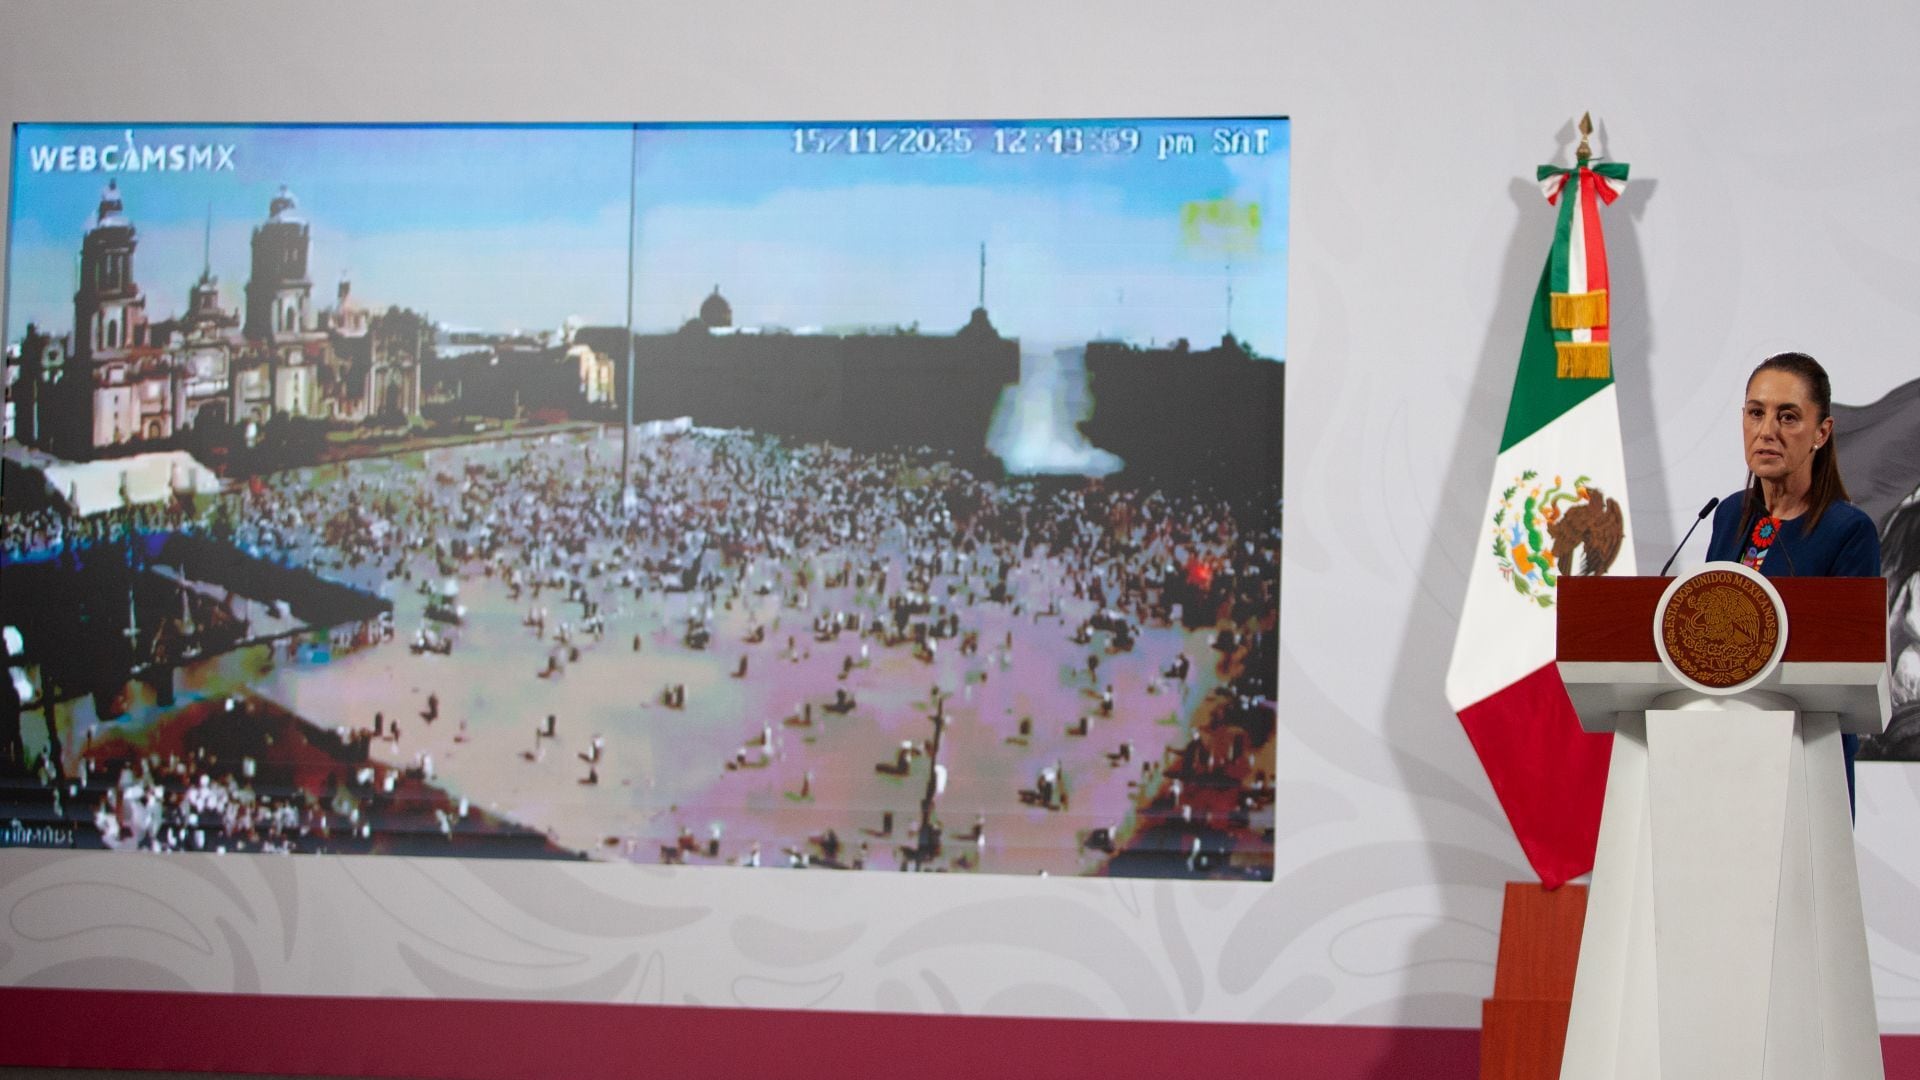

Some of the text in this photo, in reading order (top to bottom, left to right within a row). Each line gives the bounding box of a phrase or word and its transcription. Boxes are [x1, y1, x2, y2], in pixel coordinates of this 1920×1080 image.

[30, 130, 236, 172] WEBCAMSMX
[1158, 132, 1196, 161] pm
[1213, 128, 1270, 154] SAT
[1664, 573, 1776, 628] ESTADOS UNIDOS MEXICANOS
